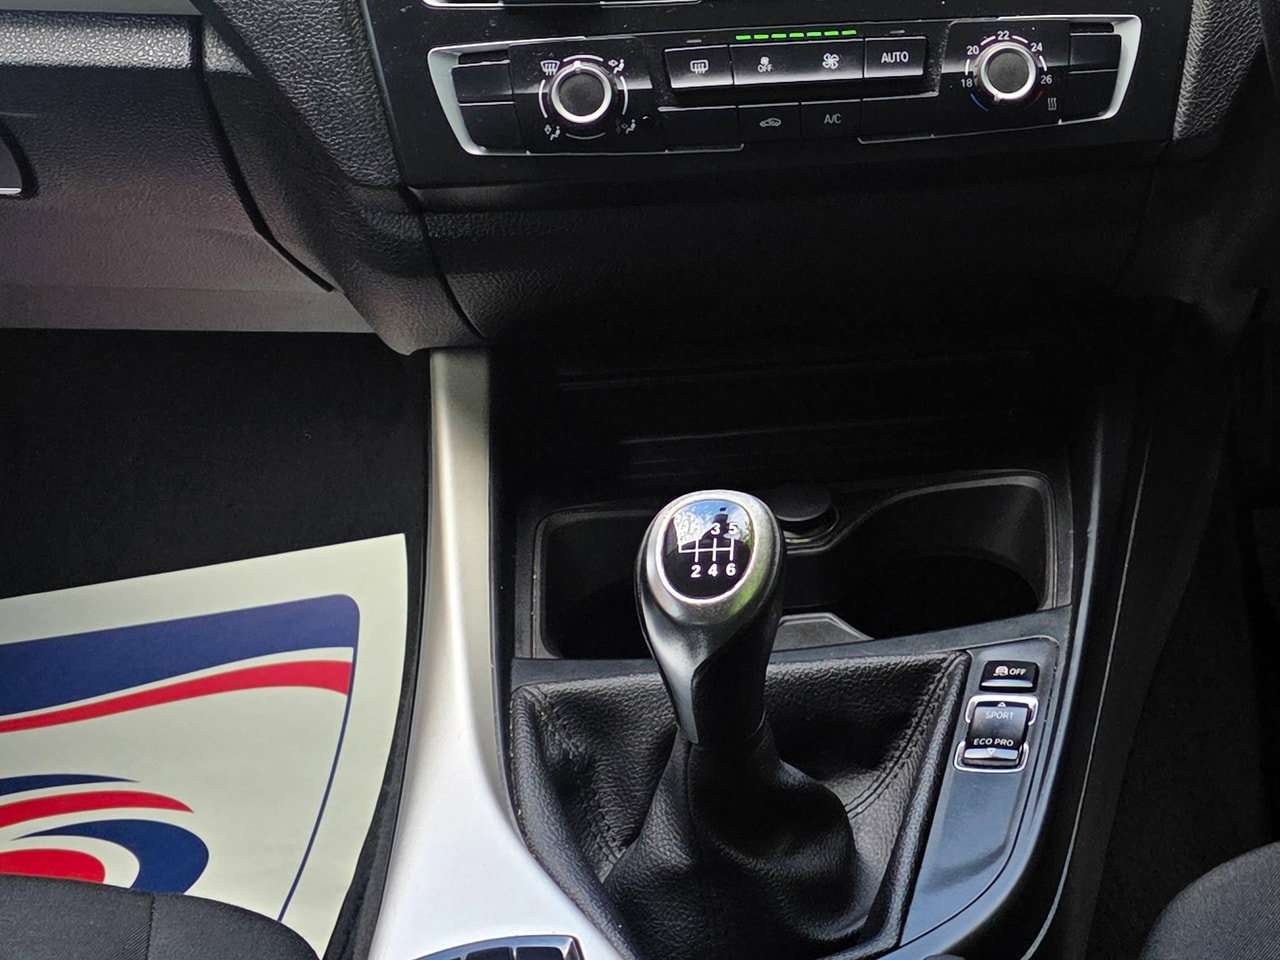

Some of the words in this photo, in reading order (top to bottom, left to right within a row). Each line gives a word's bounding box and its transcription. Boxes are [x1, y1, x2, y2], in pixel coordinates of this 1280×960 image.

[998, 30, 1010, 41] 22
[966, 44, 979, 56] 20
[1030, 41, 1044, 52] 24
[880, 50, 910, 64] AUTO
[961, 77, 972, 88] 18
[1040, 74, 1053, 86] 26
[824, 113, 841, 124] A/C
[710, 522, 720, 534] 3
[728, 522, 738, 534] 5
[690, 565, 701, 578] 2
[708, 564, 718, 576] 4
[726, 563, 736, 576] 6
[1009, 668, 1026, 676] OFF
[985, 711, 1014, 720] SPORT
[973, 738, 993, 746] ECO
[994, 738, 1014, 747] PRO
